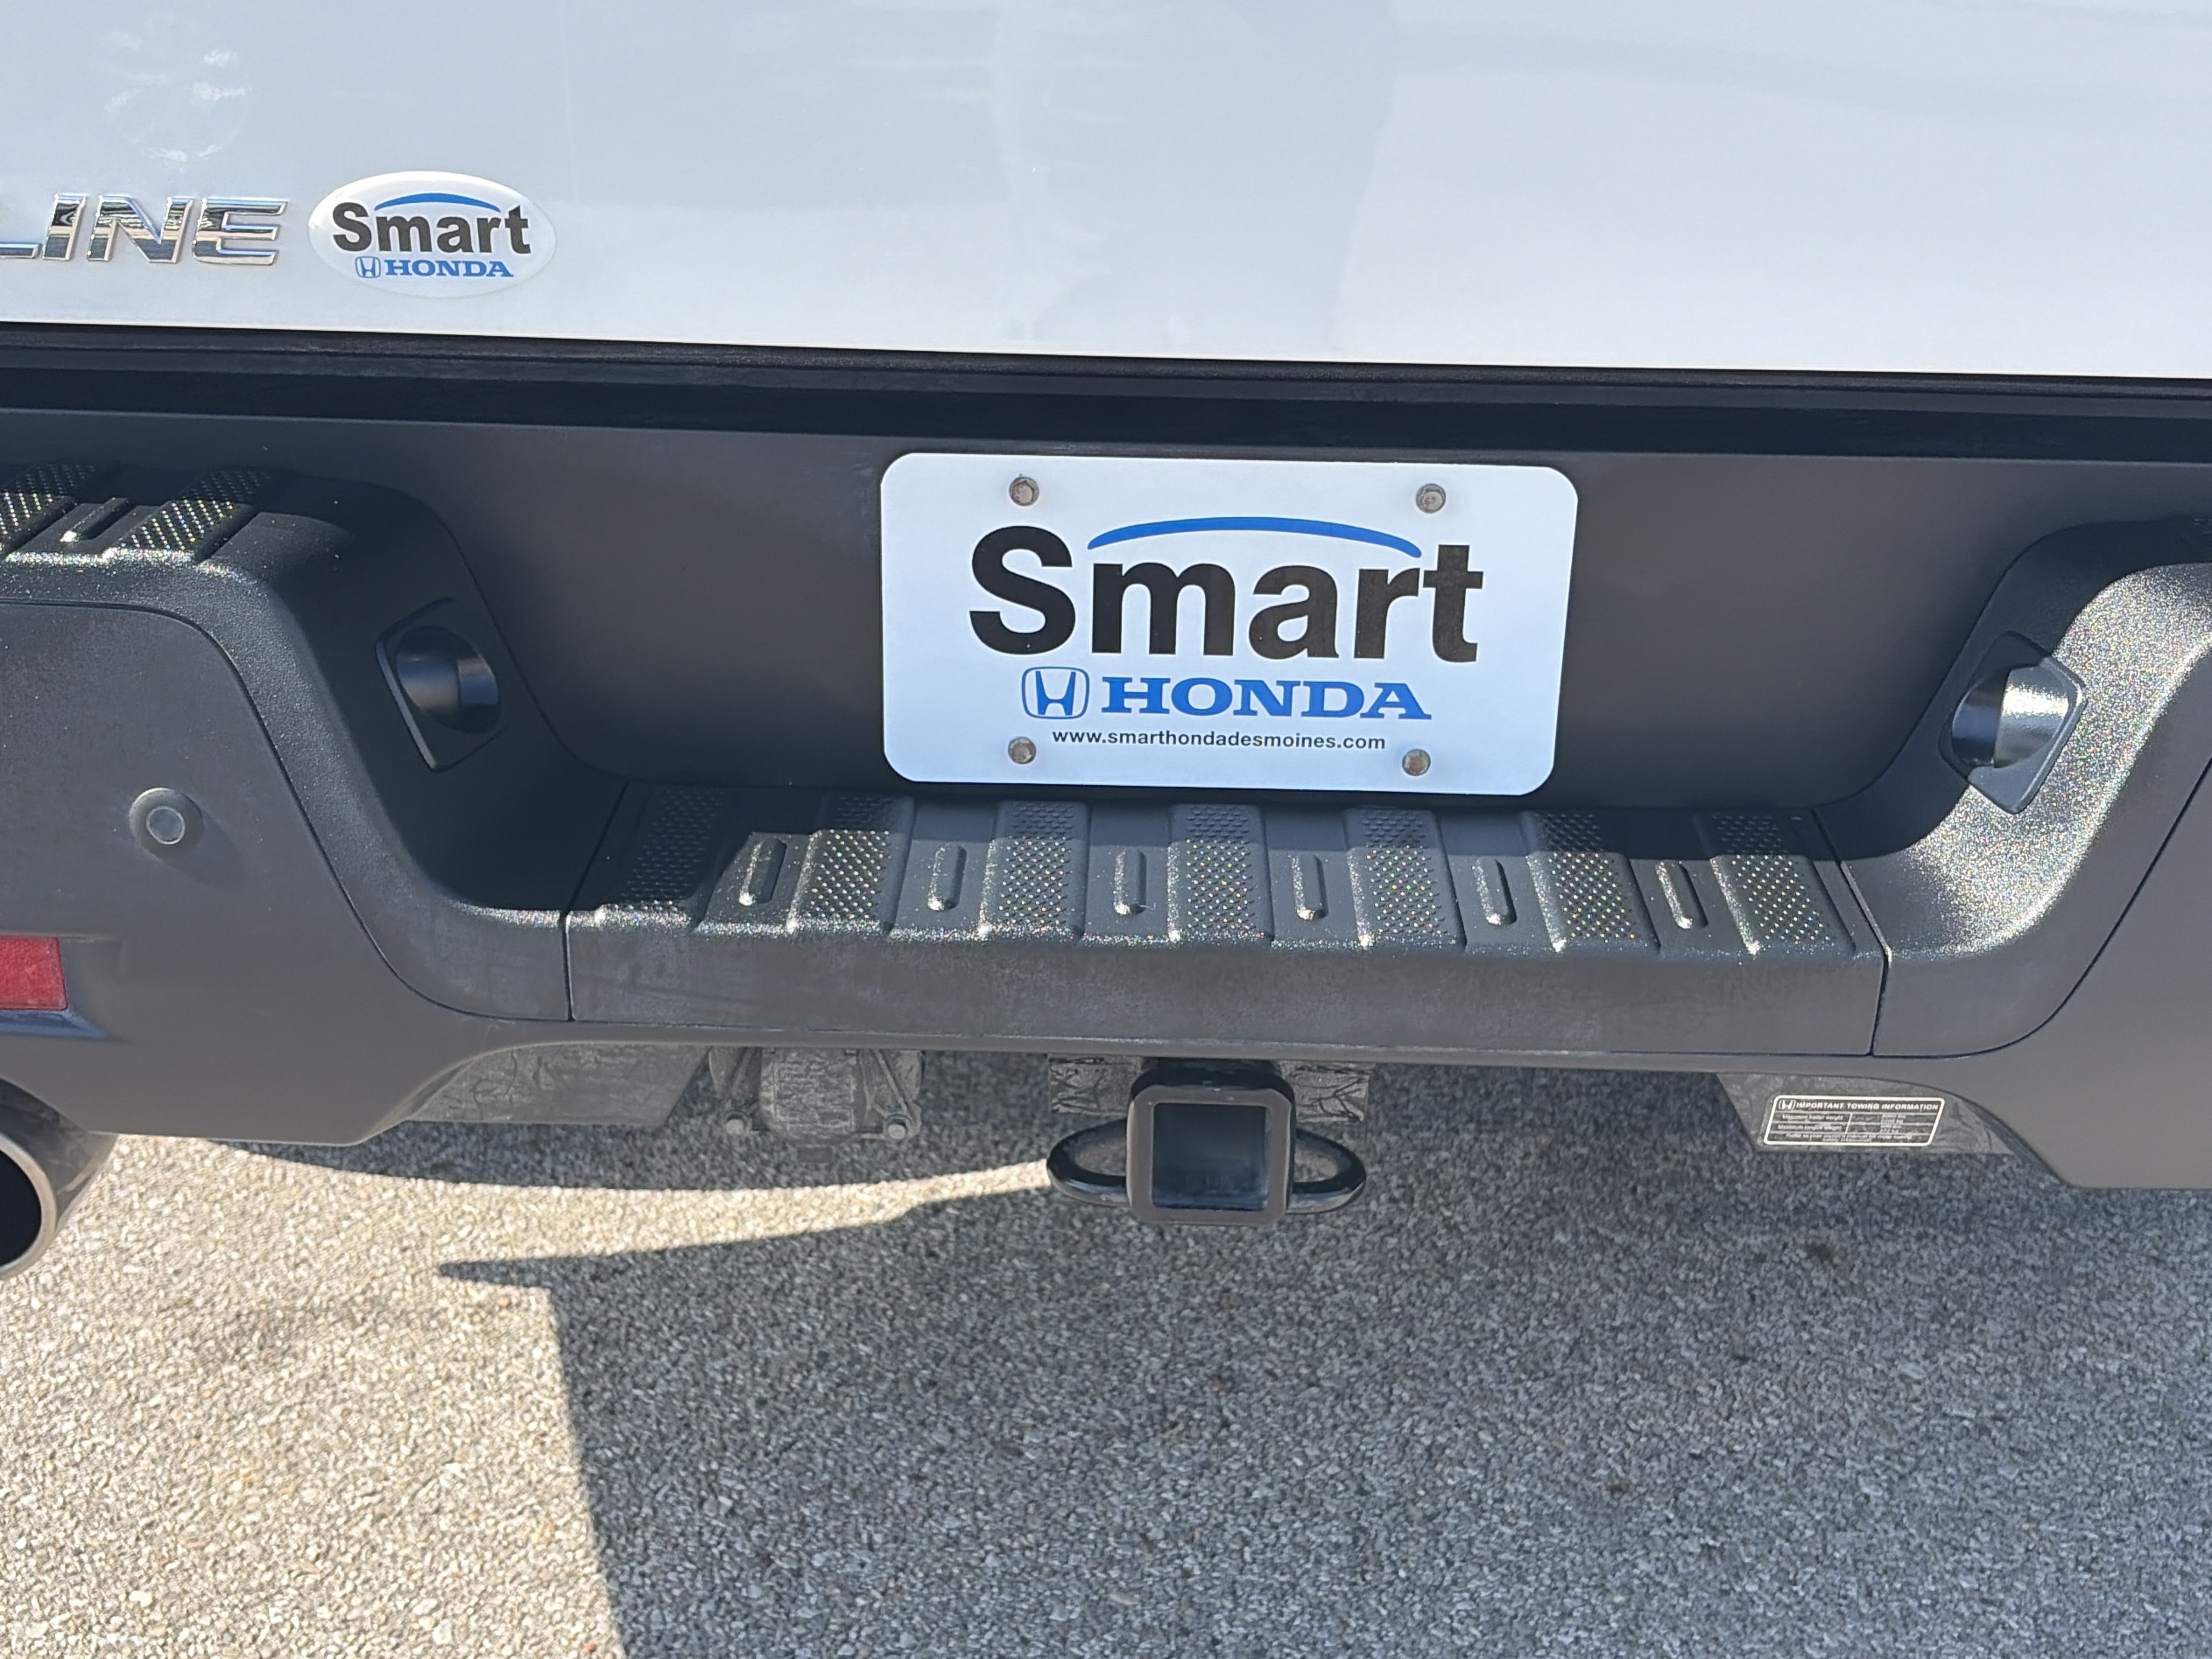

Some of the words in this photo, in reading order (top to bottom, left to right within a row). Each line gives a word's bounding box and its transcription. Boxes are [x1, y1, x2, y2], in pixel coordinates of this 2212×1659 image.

[332, 201, 532, 254] Smart
[383, 259, 514, 278] HONDA
[969, 525, 1484, 663] Smart
[1100, 675, 1432, 720] HONDA
[1052, 730, 1386, 751] www.smarthondadesmoines.com
